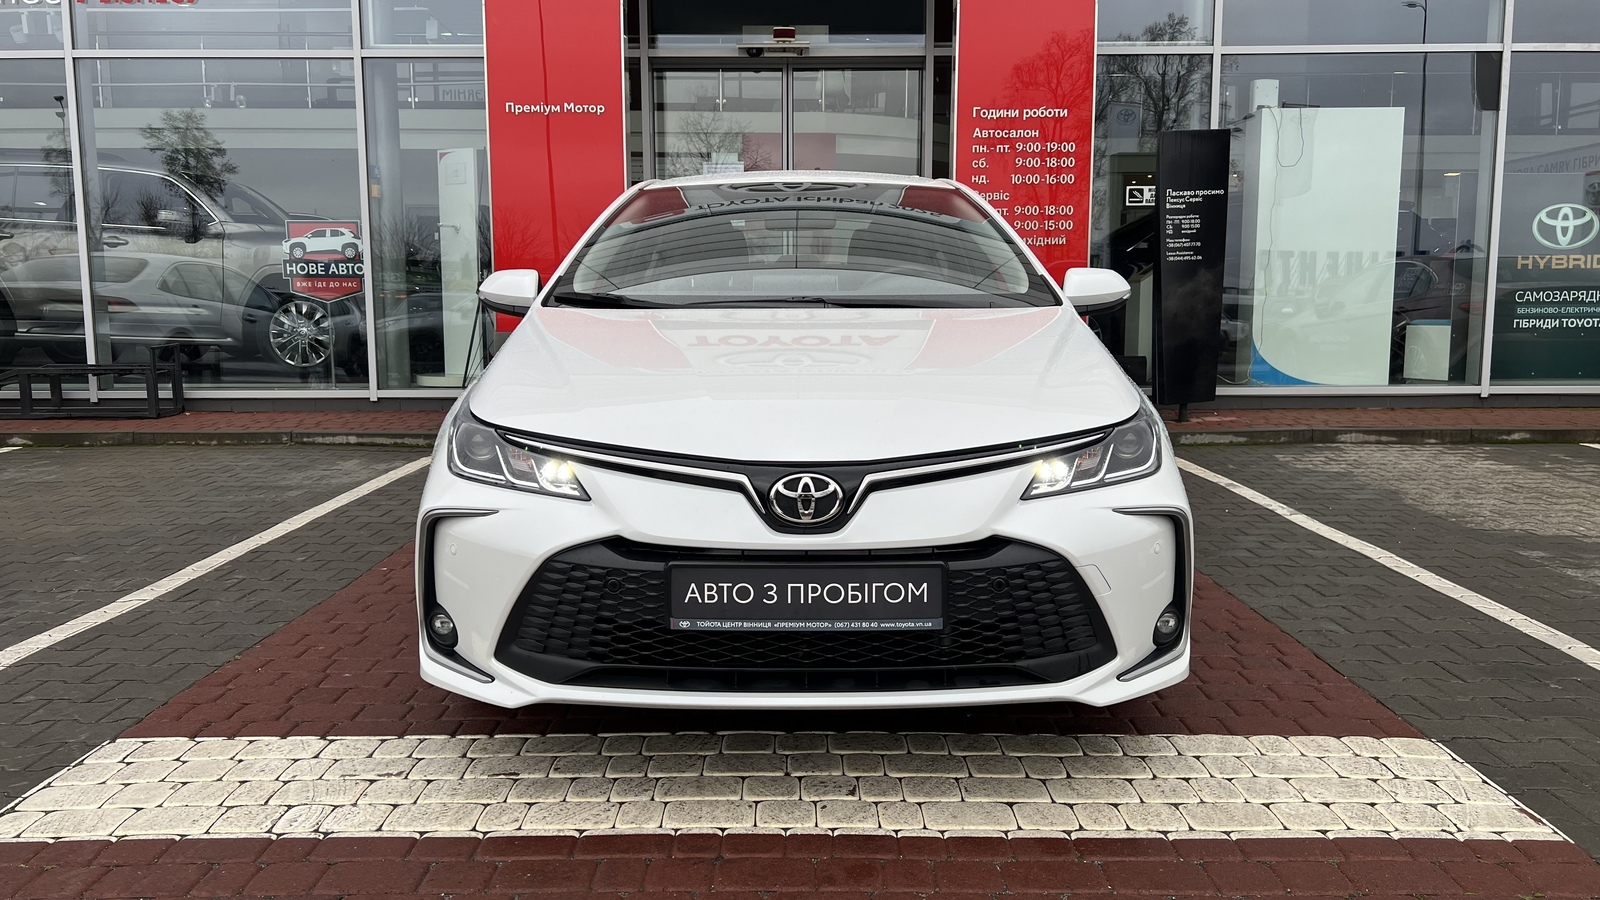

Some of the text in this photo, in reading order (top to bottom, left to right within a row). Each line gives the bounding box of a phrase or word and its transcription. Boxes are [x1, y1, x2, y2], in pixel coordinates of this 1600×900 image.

[505, 102, 605, 115] Преміум Мотор
[972, 106, 1068, 120] Години роботи
[973, 128, 1039, 138] Автосалон
[1015, 142, 1076, 153] 9:00-19:00
[972, 157, 1076, 168] сб. 9:00-18:00
[971, 174, 1075, 184] нд. 10:00-16:00
[975, 190, 1010, 202] ервіс
[1014, 205, 1074, 216] 9:00-18:00
[1013, 220, 1073, 231] 9:00-15:00
[286, 263, 364, 274] НОВЕ АВТО
[1513, 319, 1560, 330] ГІБРИДИ
[684, 583, 928, 604] АВТО З ПРОБІГОМ
